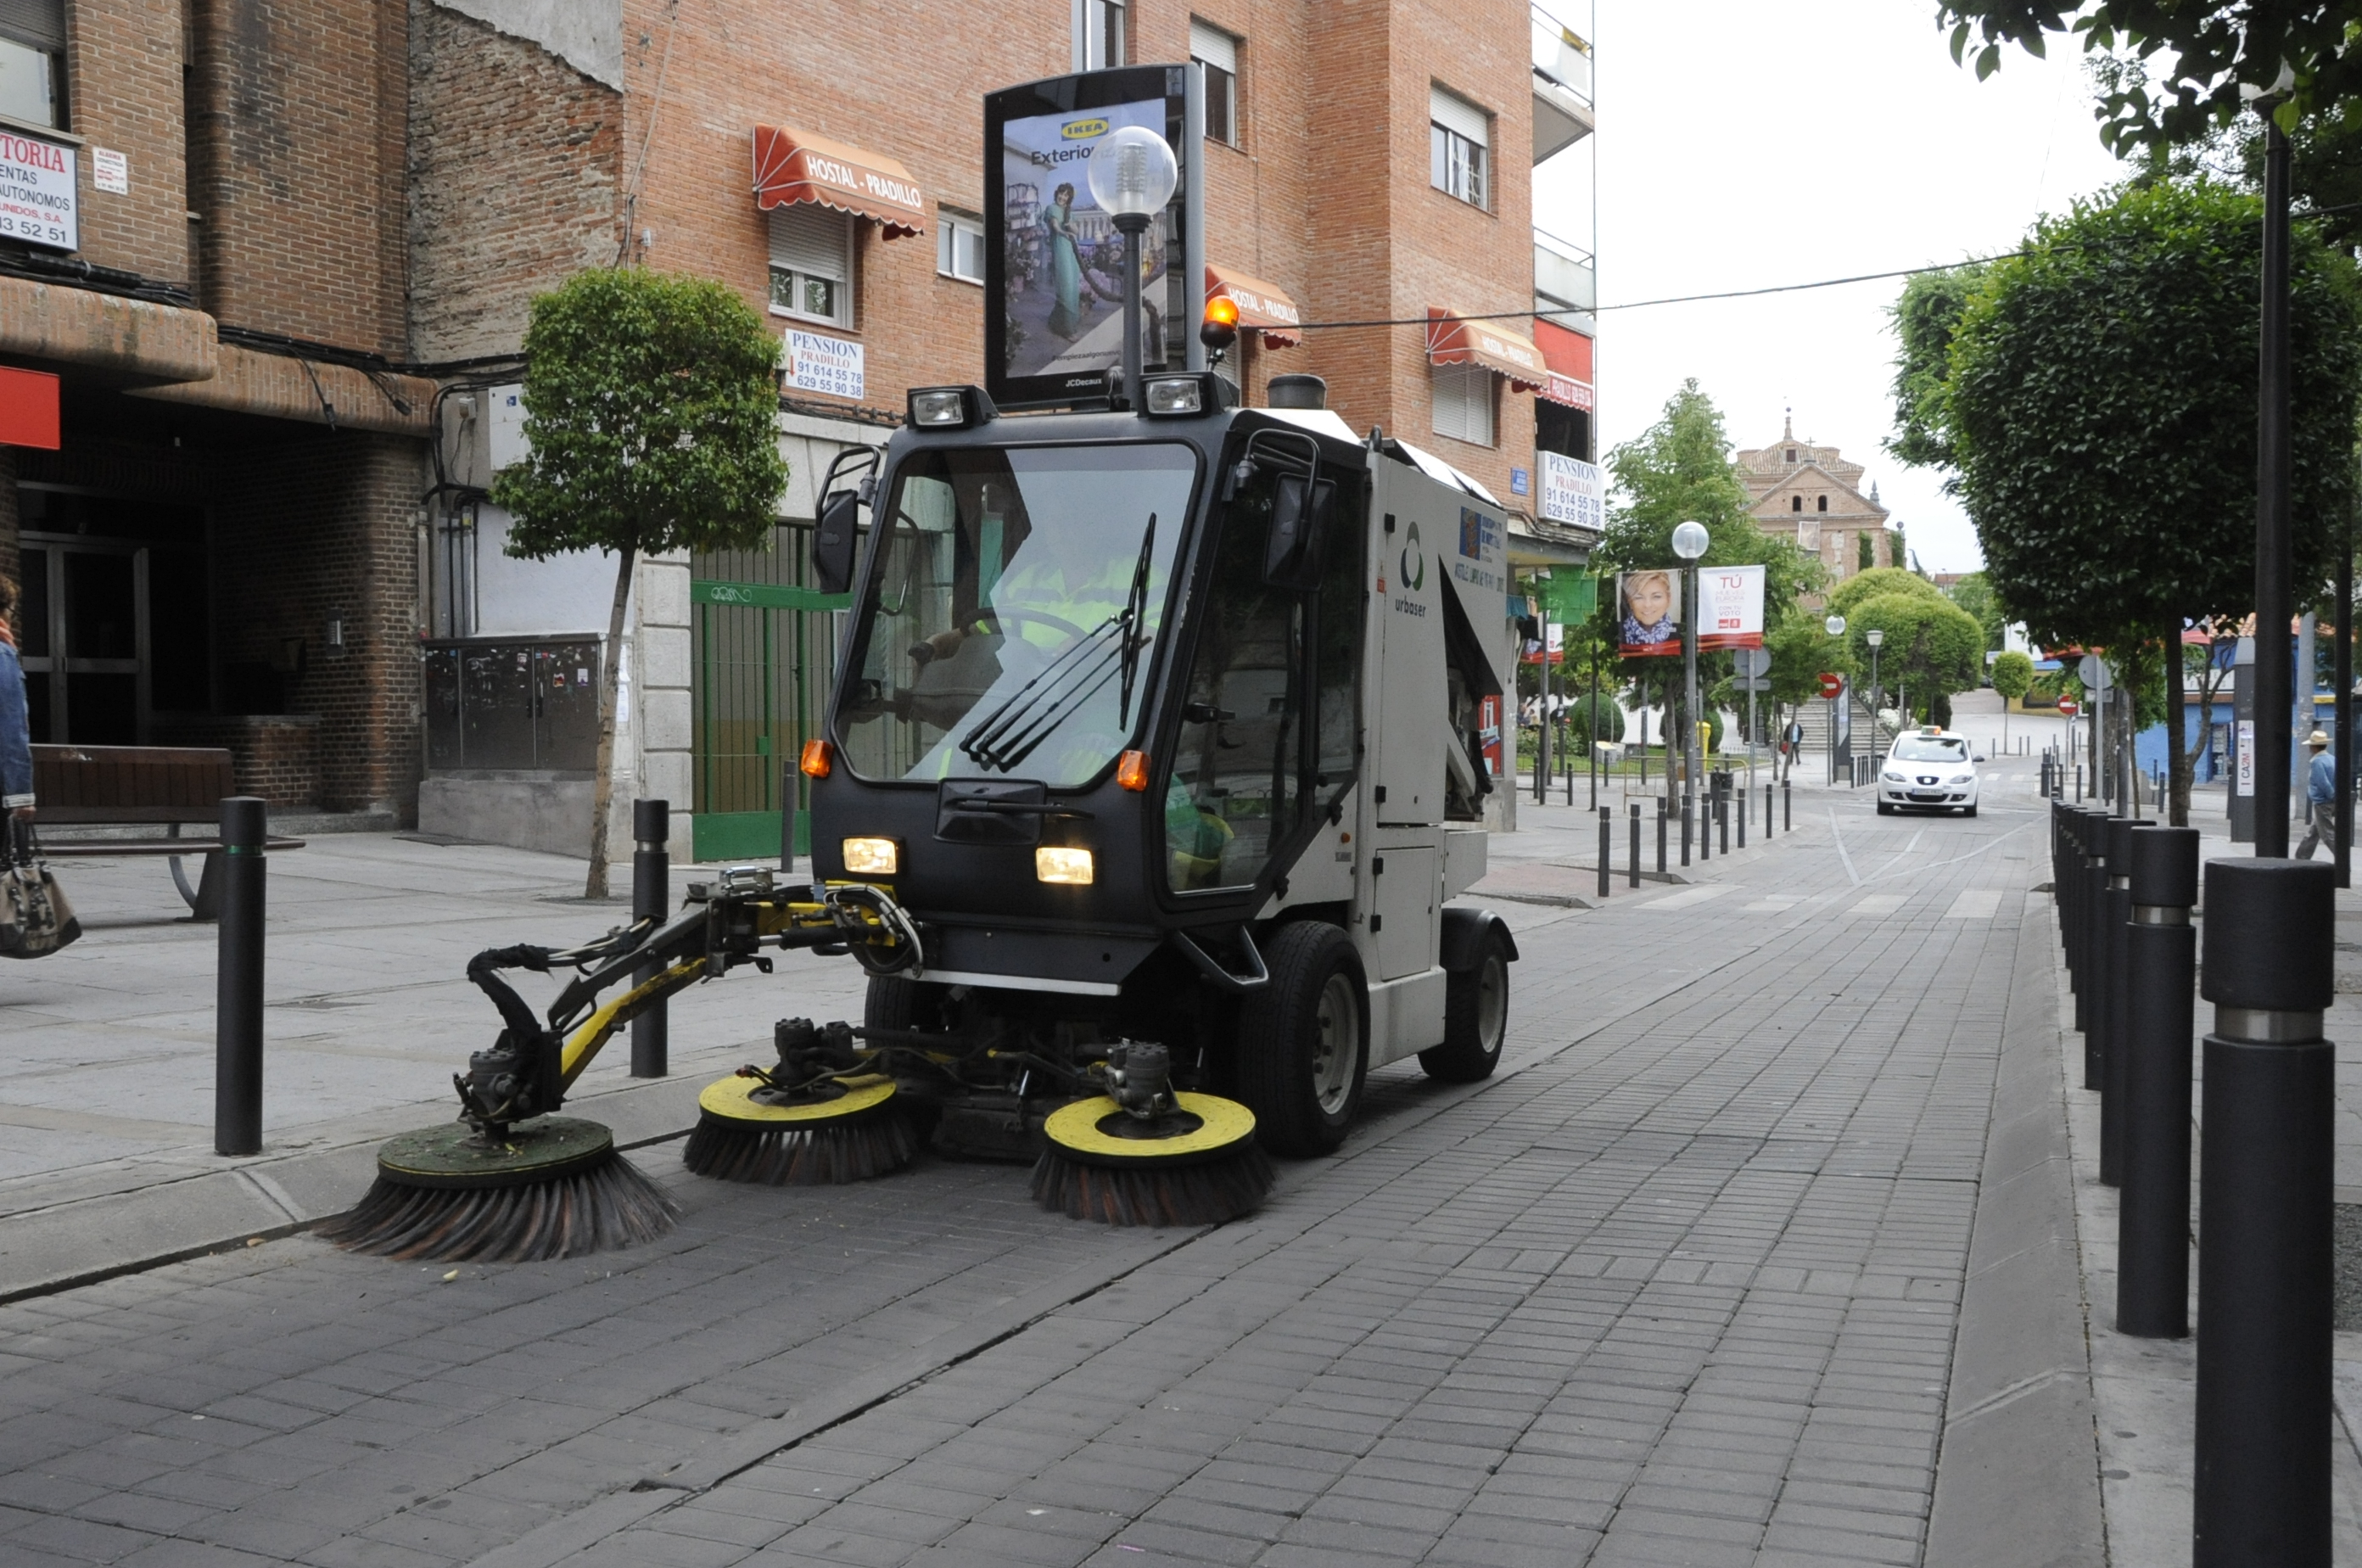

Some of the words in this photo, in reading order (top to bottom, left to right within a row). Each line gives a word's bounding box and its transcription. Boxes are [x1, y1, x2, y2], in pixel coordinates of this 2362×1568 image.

[1067, 122, 1103, 135] IKEA
[805, 154, 859, 190] HOSTAL
[865, 173, 922, 209] PRADILLO
[20, 221, 42, 238] 52
[48, 227, 67, 243] 51
[1228, 287, 1261, 313] HOSTAL
[1263, 299, 1300, 325] PRADILLO
[792, 333, 858, 359] PENSION
[801, 350, 850, 369] PRADILLO
[798, 361, 809, 373] 91
[814, 365, 831, 378] 614
[836, 369, 848, 381] 55
[851, 372, 863, 384] 78
[1066, 378, 1102, 388] JCDecaux
[798, 374, 816, 388] 629
[820, 378, 831, 391] 55
[835, 382, 847, 395] 90
[850, 385, 862, 396] 38
[1549, 455, 1598, 482] PENSION
[1555, 474, 1592, 496] PRADILLO
[1547, 487, 1557, 501] 91
[1560, 490, 1576, 506] 614
[1578, 495, 1588, 510] 55
[1590, 498, 1600, 513] 78
[1547, 502, 1563, 518] 629
[1565, 507, 1576, 521] 55
[1578, 510, 1588, 524] 90
[1590, 513, 1600, 528] 38
[1719, 574, 1742, 589] TÚ
[1395, 594, 1426, 618] urbaser
